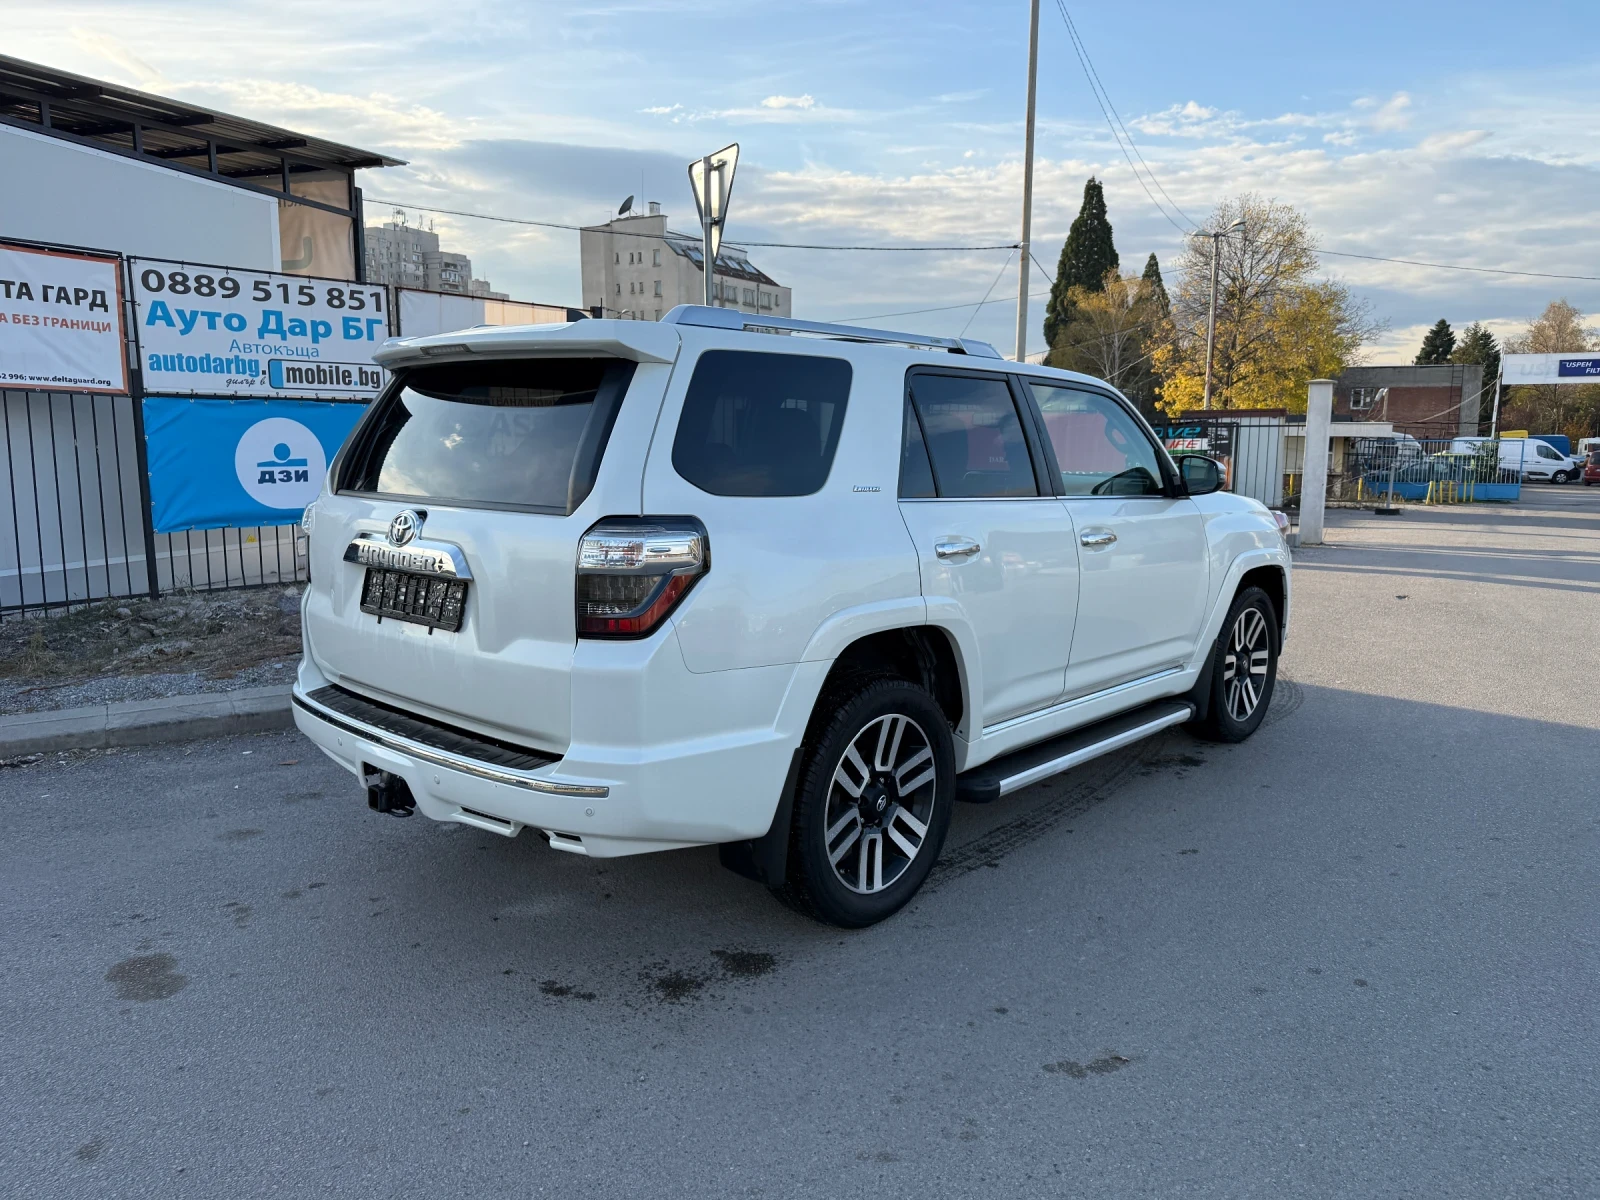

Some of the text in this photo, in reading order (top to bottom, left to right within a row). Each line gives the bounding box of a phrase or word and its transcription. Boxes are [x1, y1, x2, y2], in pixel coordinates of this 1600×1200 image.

[41, 284, 109, 313] ГАРД
[141, 269, 382, 312] 0889 515 851
[12, 313, 40, 326] БЕЗ
[43, 316, 111, 334] ГРАНИЦИ
[145, 300, 383, 344] Ауто Дар БГ
[229, 339, 319, 359] Автокъща
[28, 375, 111, 386] www.deltaguard.org
[285, 364, 380, 389] mobile.bg
[257, 469, 309, 484] ДЗИ
